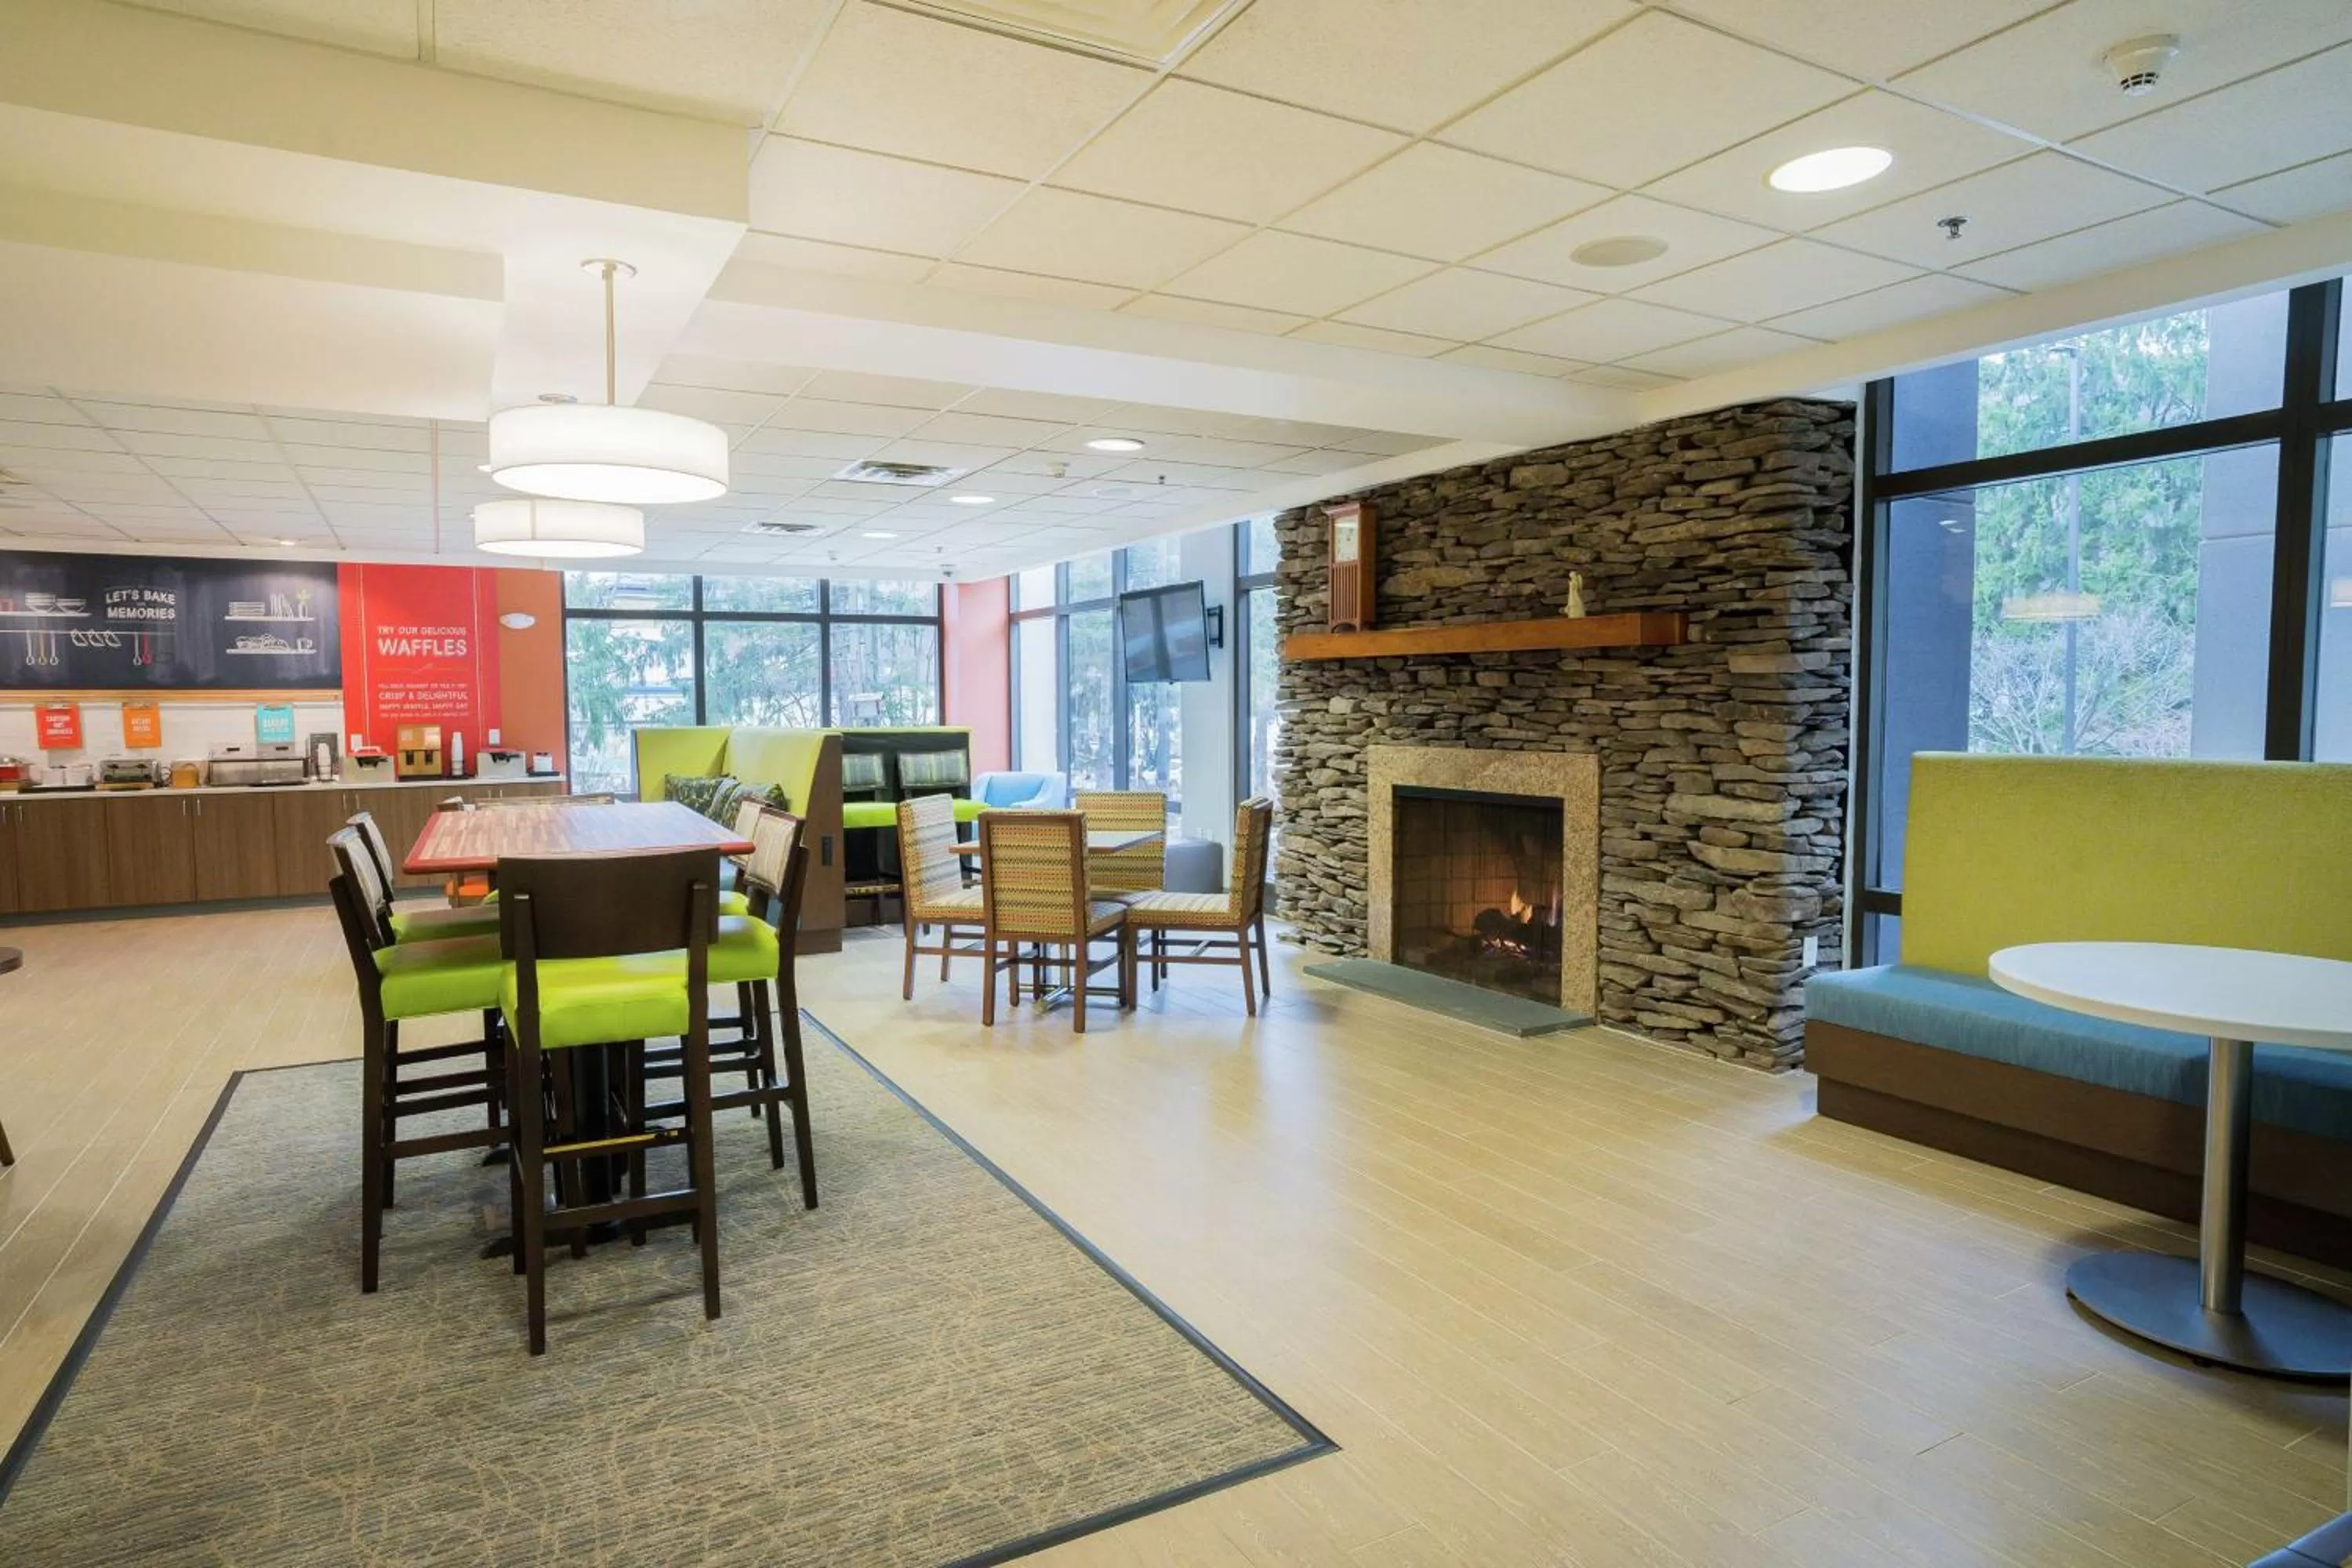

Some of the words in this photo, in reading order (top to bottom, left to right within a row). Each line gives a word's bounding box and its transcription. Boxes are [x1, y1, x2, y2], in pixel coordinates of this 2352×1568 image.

[106, 590, 140, 604] LET'S
[143, 590, 176, 605] BAKE
[107, 607, 176, 619] MEMORIES
[420, 626, 466, 635] DELICIOUS
[378, 639, 467, 655] WAFFLES
[417, 691, 468, 700] DELIGHTFUL
